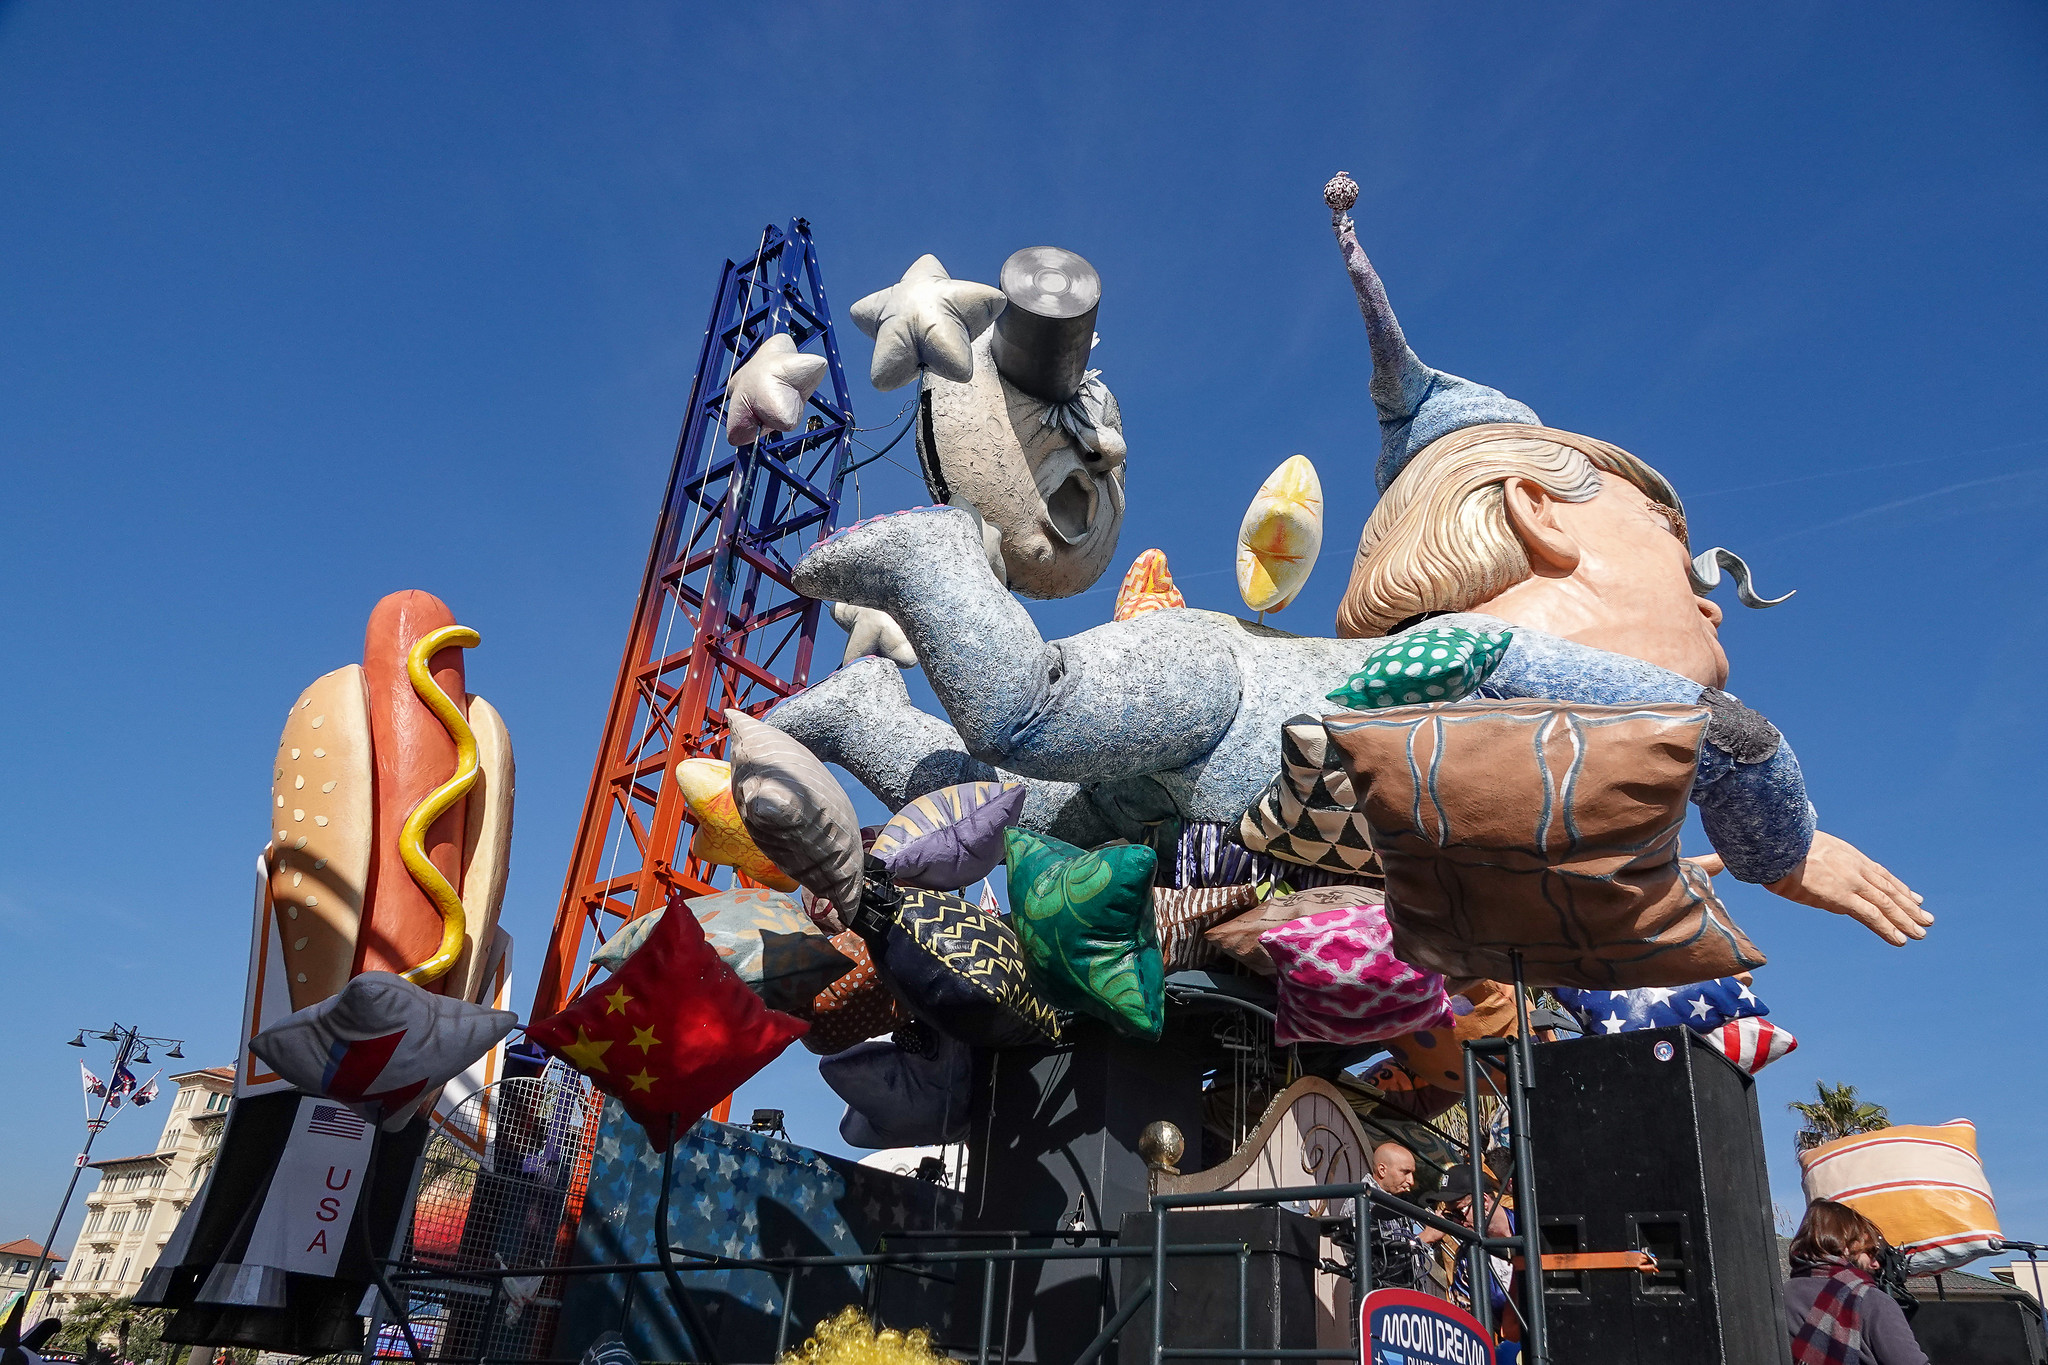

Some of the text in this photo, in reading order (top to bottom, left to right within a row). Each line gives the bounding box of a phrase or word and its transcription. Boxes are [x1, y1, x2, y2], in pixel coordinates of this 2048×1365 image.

[306, 1166, 352, 1255] USA
[1381, 1313, 1485, 1365] MOON DREAM
